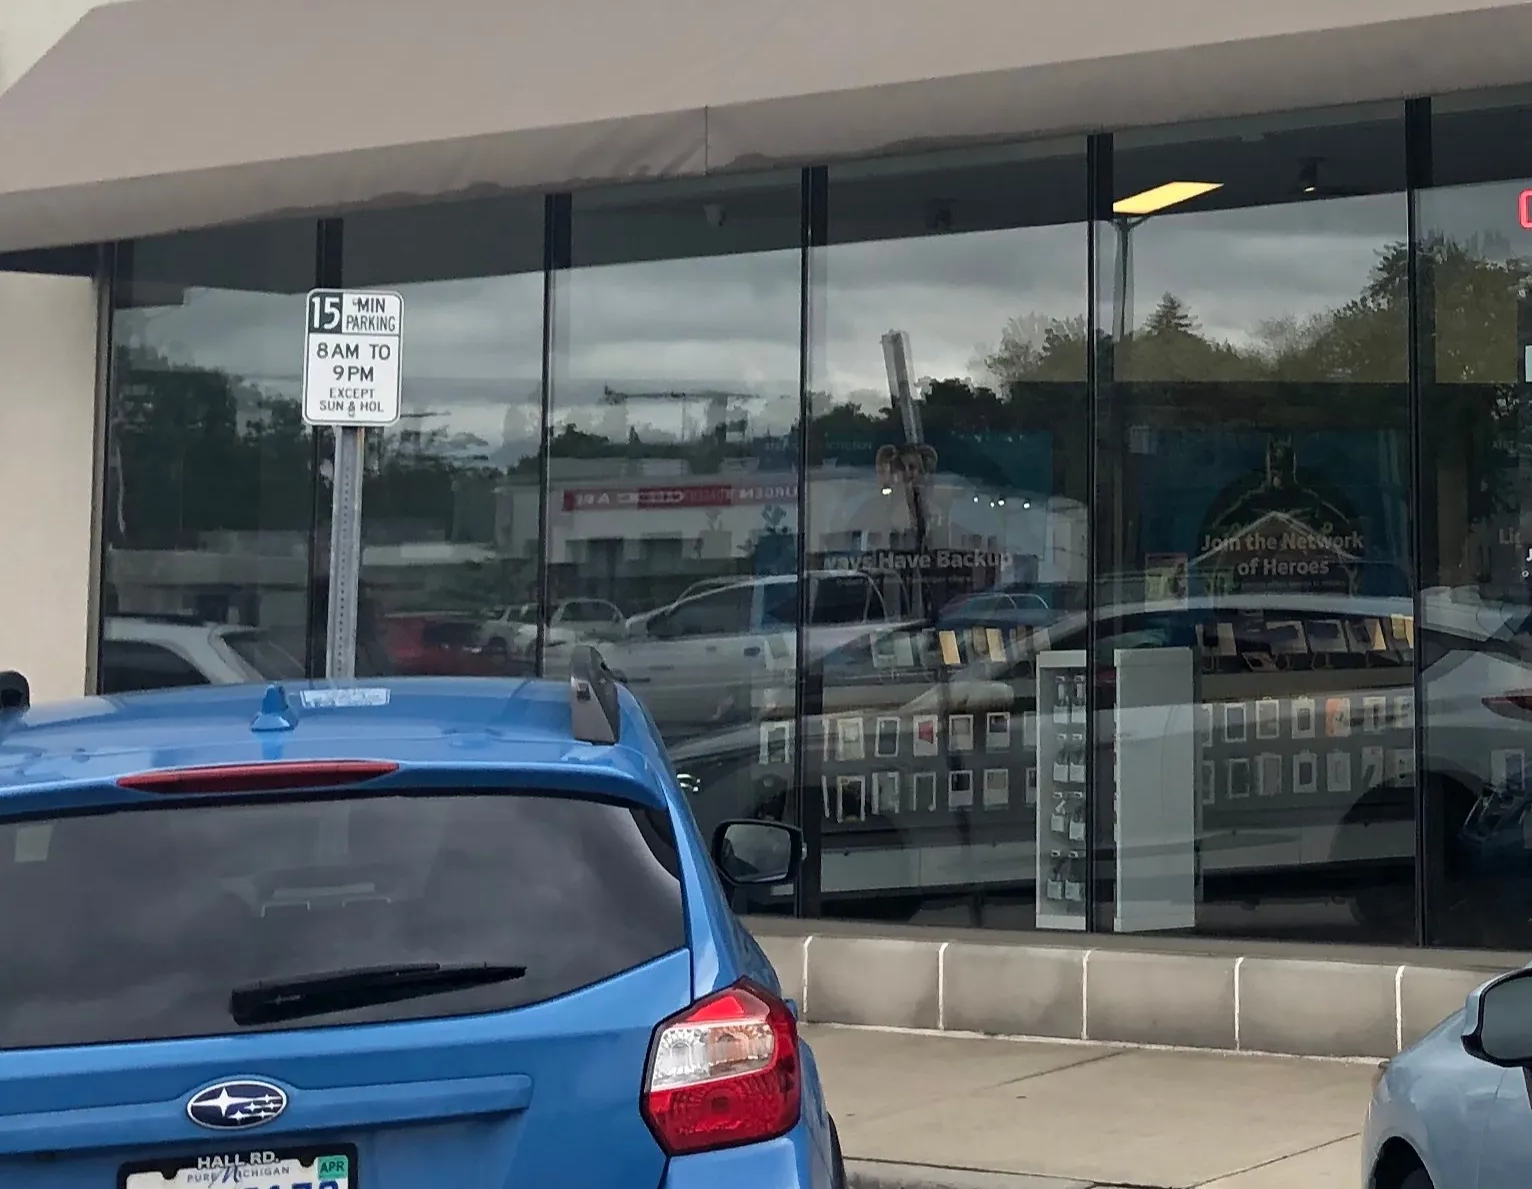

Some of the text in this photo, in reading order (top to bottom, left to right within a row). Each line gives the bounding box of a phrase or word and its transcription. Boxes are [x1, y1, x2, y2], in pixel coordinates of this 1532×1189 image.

[312, 296, 341, 330] 15
[356, 297, 386, 313] MIN
[346, 314, 396, 332] PARKING
[316, 342, 391, 361] 8AM TO
[332, 365, 374, 382] 9PM
[329, 387, 375, 399] EXCEPT
[319, 400, 344, 412] SUN
[347, 401, 355, 412] &
[1201, 530, 1364, 552] Join the Network
[878, 551, 932, 570] Have
[936, 548, 1013, 573] Backup
[1237, 557, 1330, 577] of Heroes
[197, 1150, 280, 1171] HALL RD.
[319, 1160, 345, 1175] APR
[187, 1172, 217, 1183] PURE
